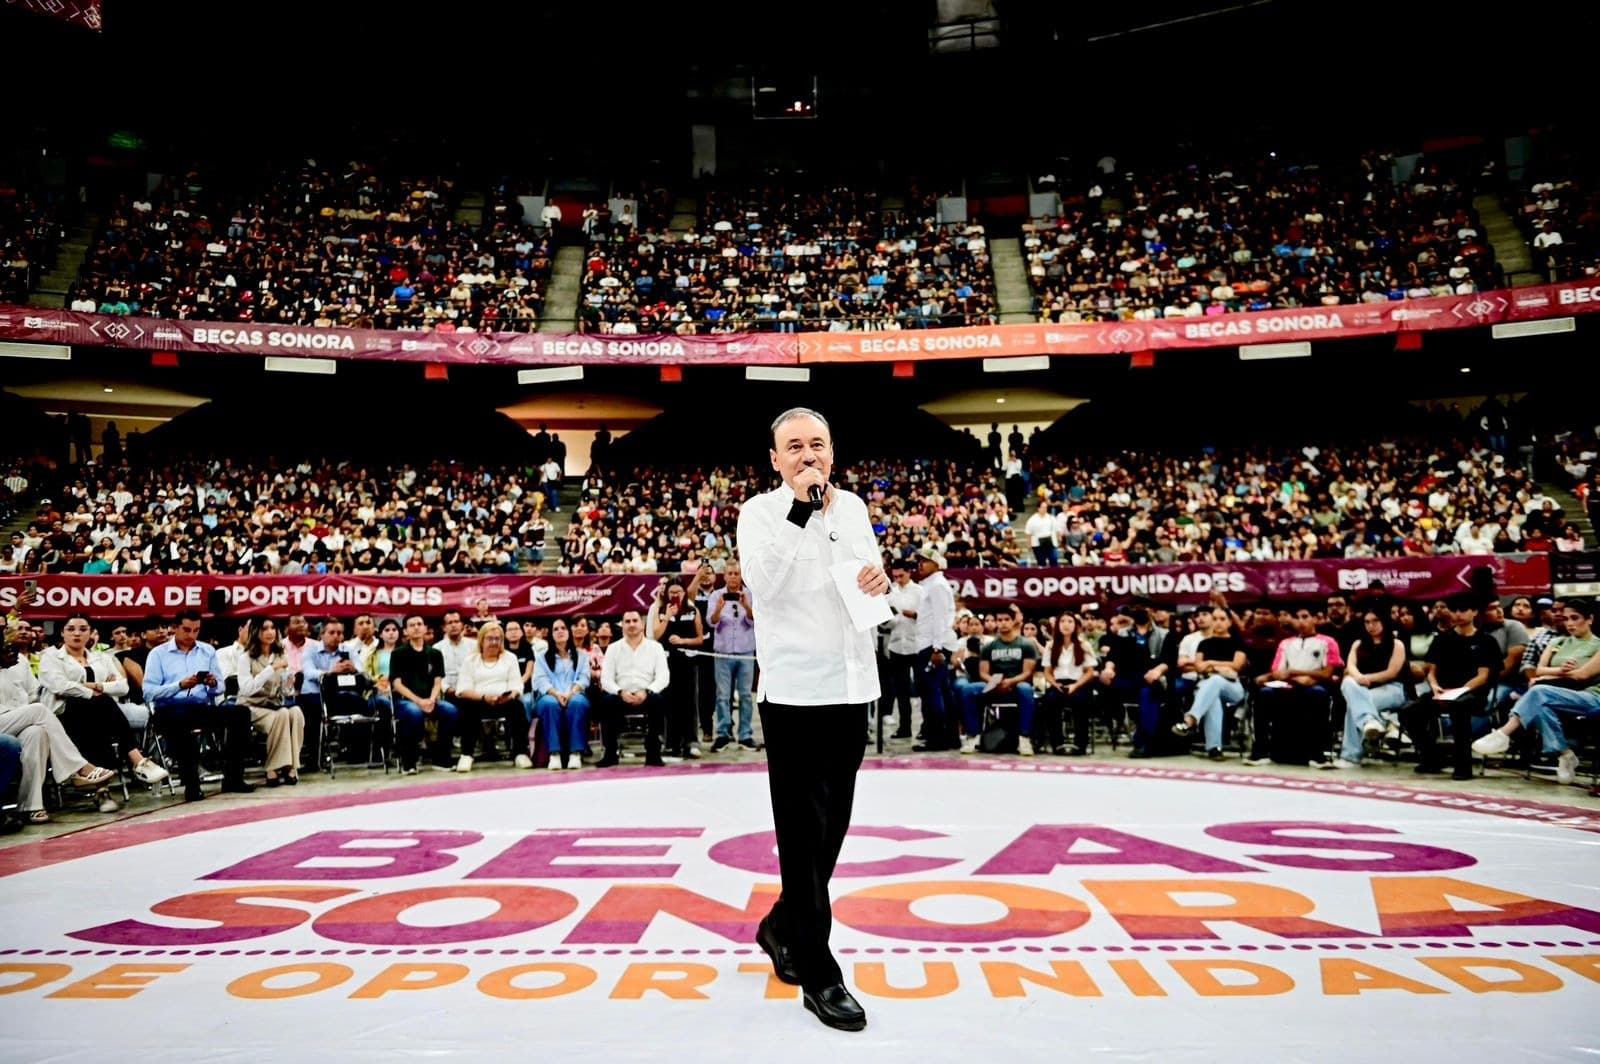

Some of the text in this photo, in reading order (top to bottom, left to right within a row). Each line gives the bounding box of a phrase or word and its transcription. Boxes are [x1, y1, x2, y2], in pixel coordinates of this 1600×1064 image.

[1185, 320, 1251, 339] BECAS
[1256, 312, 1343, 335] SONORA
[193, 328, 263, 346] BECAS
[268, 332, 355, 350] SONORA
[542, 340, 603, 356] BECAS
[607, 341, 685, 357] SONORA
[861, 338, 919, 354] BECAS
[924, 333, 1002, 350] SONORA
[164, 586, 202, 606] DE
[984, 578, 1018, 598] DE
[1023, 572, 1246, 597] OPORTUNIDADES
[194, 821, 1479, 881] BECAS
[65, 875, 1600, 946] SONORA
